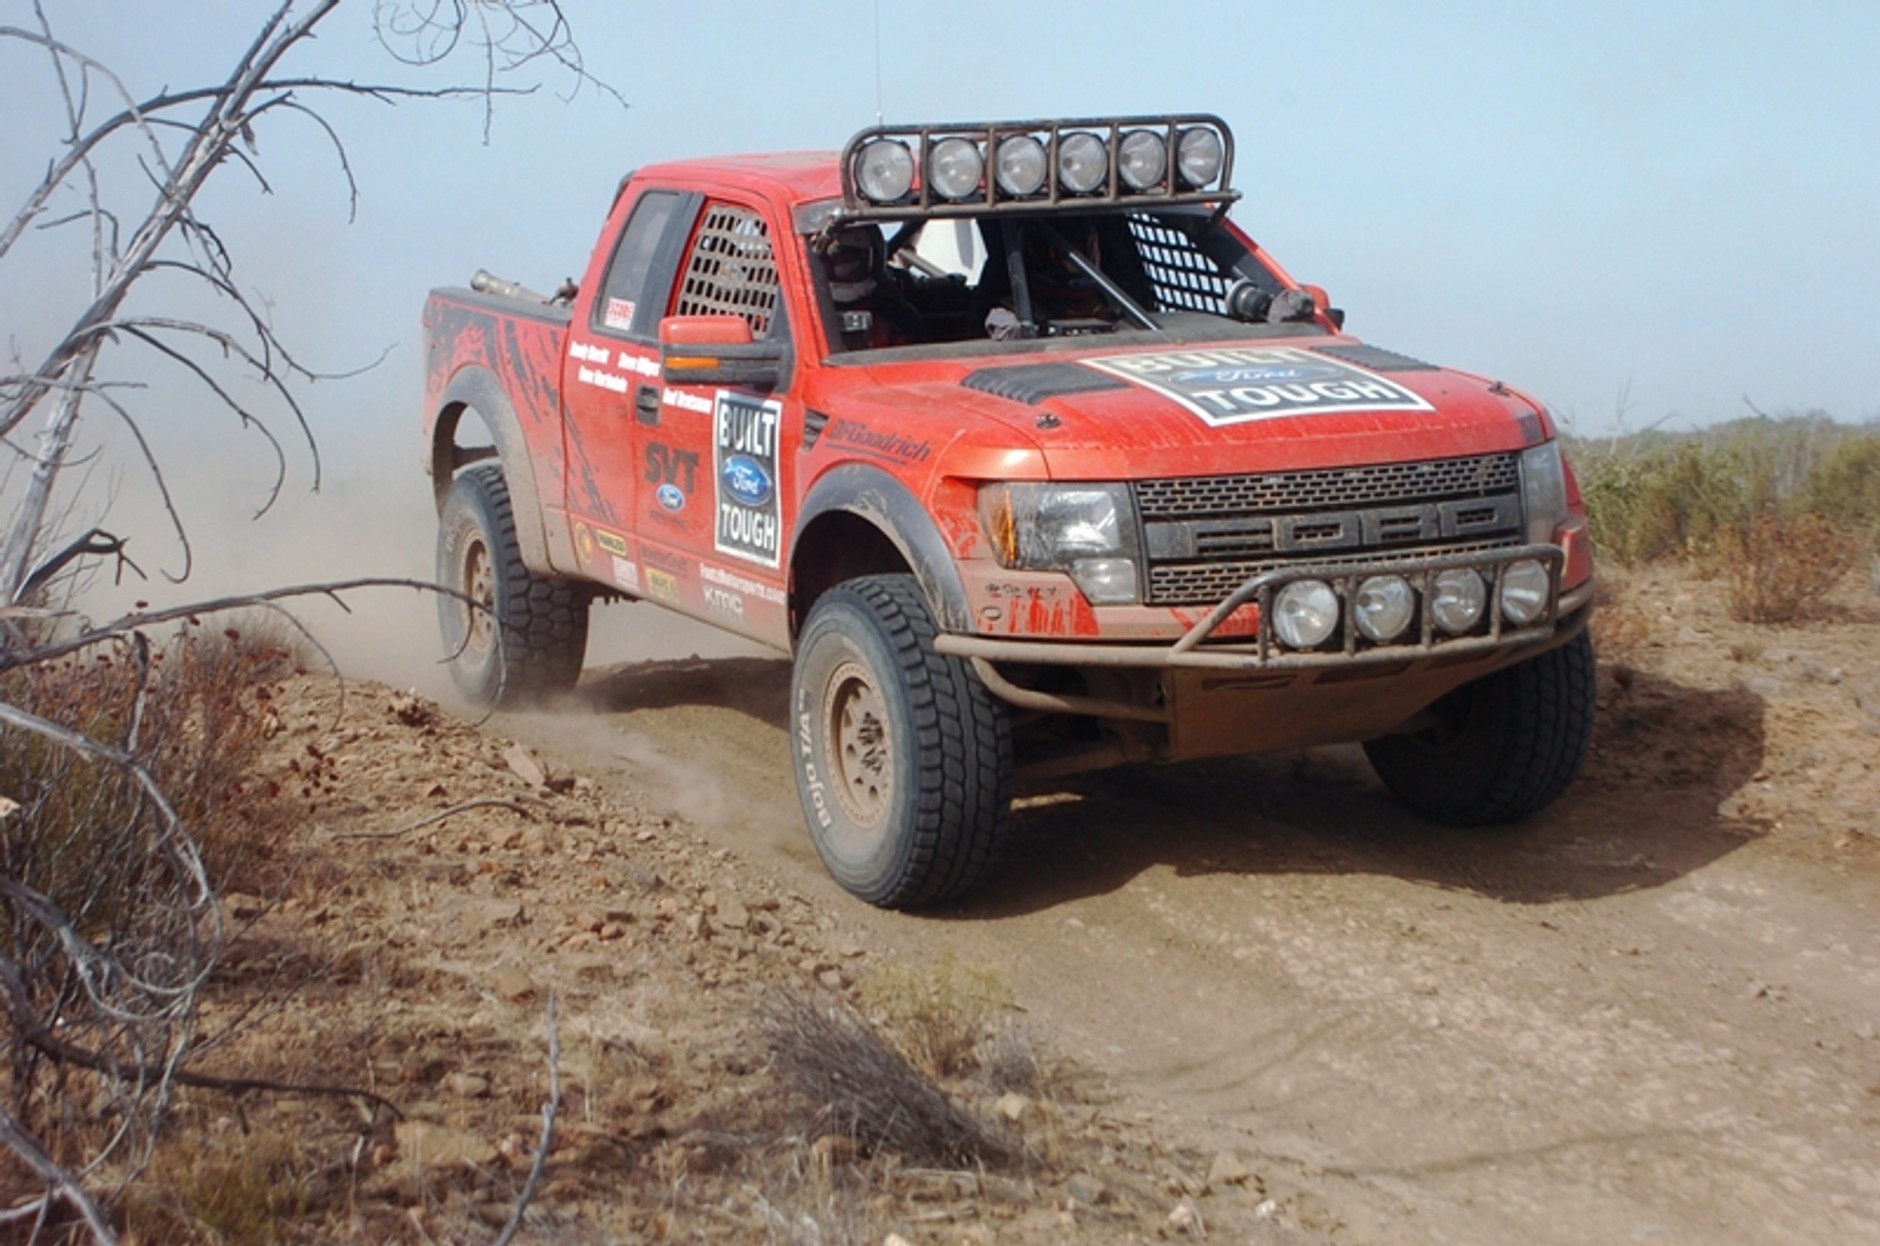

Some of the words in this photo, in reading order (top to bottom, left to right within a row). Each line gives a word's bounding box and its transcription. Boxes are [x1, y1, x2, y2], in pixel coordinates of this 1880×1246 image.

[1108, 349, 1306, 372] BUILT
[1215, 367, 1302, 382] Ford
[1191, 380, 1401, 411] TOUGH
[719, 403, 775, 457] BUILT
[644, 442, 700, 494] SVT
[732, 464, 760, 496] Ford
[721, 502, 775, 552] TOUGH
[799, 712, 813, 758] T/A
[806, 763, 832, 828] Baja
